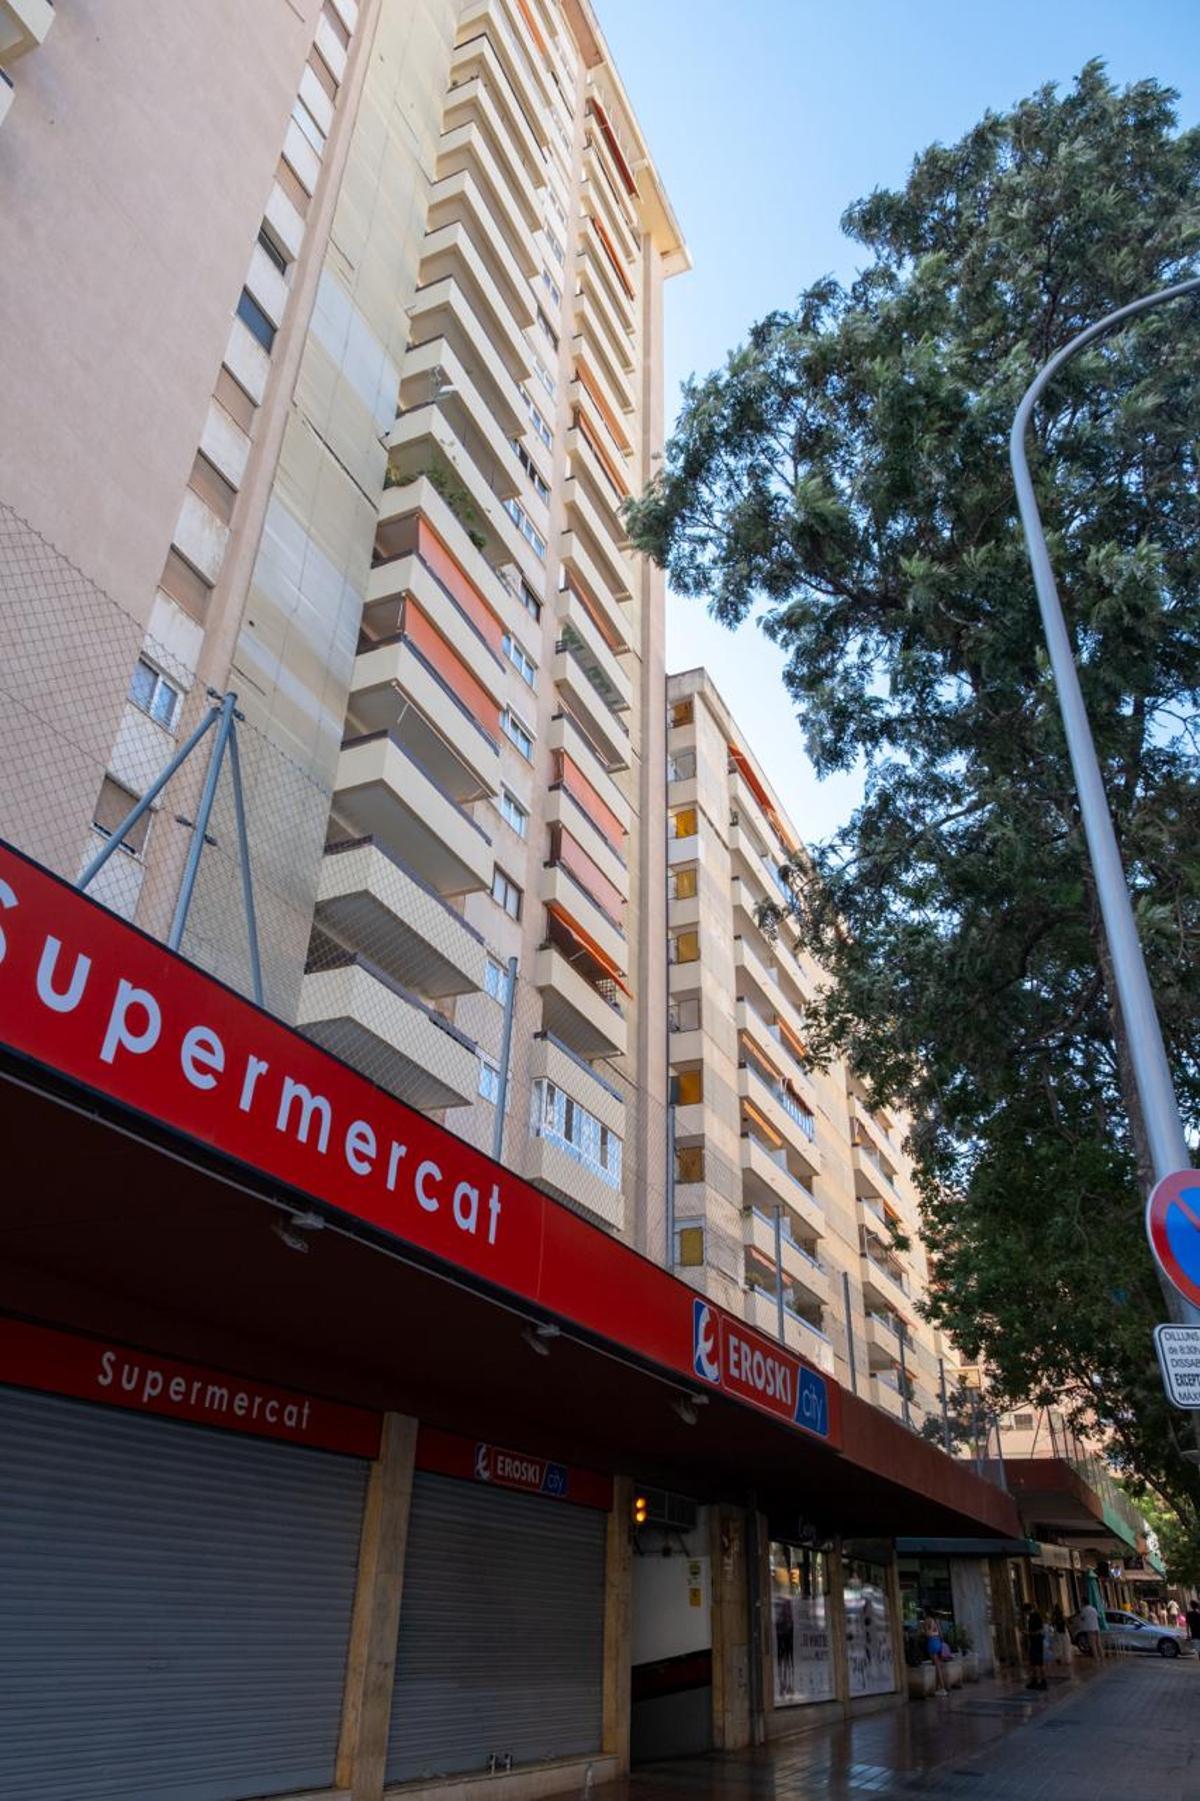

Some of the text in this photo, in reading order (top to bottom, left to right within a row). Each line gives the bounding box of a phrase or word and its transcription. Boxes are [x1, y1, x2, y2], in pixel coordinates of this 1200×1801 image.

[97, 1351, 311, 1430] Supermercat
[728, 1335, 823, 1430] EROSKI city
[497, 1455, 564, 1495] EROSKI city
